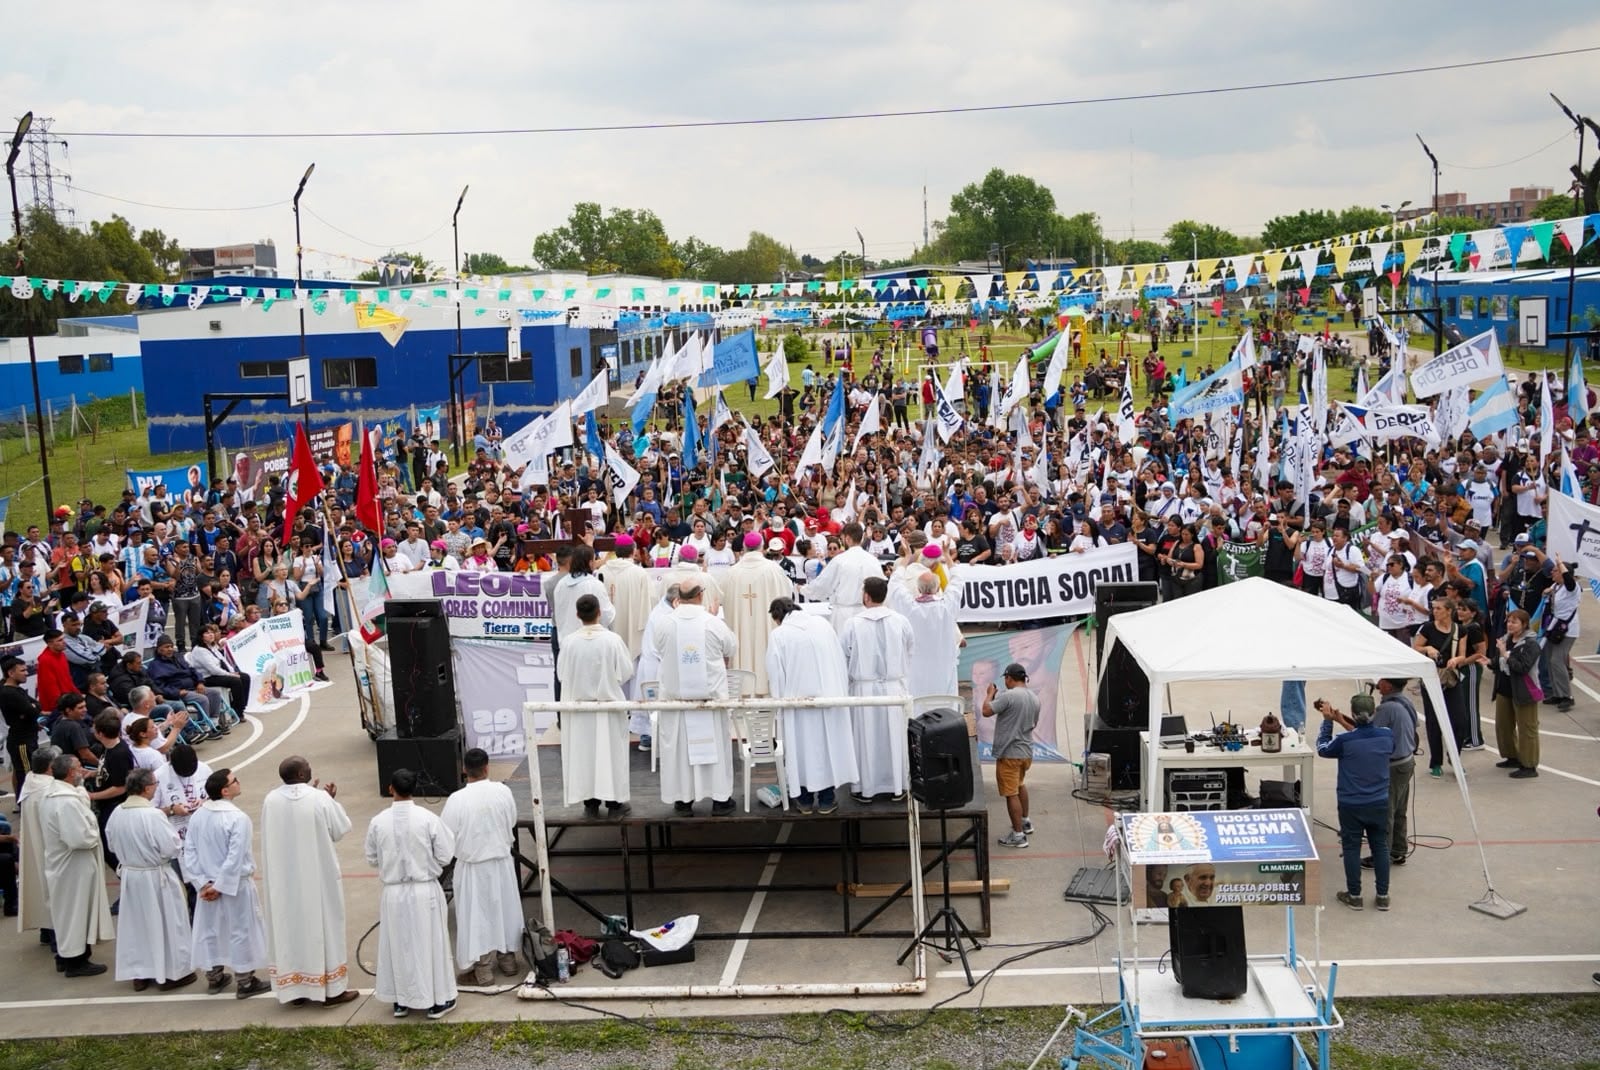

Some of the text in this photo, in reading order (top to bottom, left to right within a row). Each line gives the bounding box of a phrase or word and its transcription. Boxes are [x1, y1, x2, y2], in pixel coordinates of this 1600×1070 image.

[264, 457, 289, 473] POBRE
[431, 571, 541, 597] LEON
[443, 599, 478, 618] ORAS
[483, 621, 520, 635] Tierra
[1213, 813, 1296, 823] HIJOS DE UNA
[1216, 822, 1295, 835] MISMA
[1220, 835, 1267, 845] MADRE
[1218, 882, 1299, 893] IGLESIA POBRE Y
[1215, 893, 1301, 903] PARA LOS POBRES
